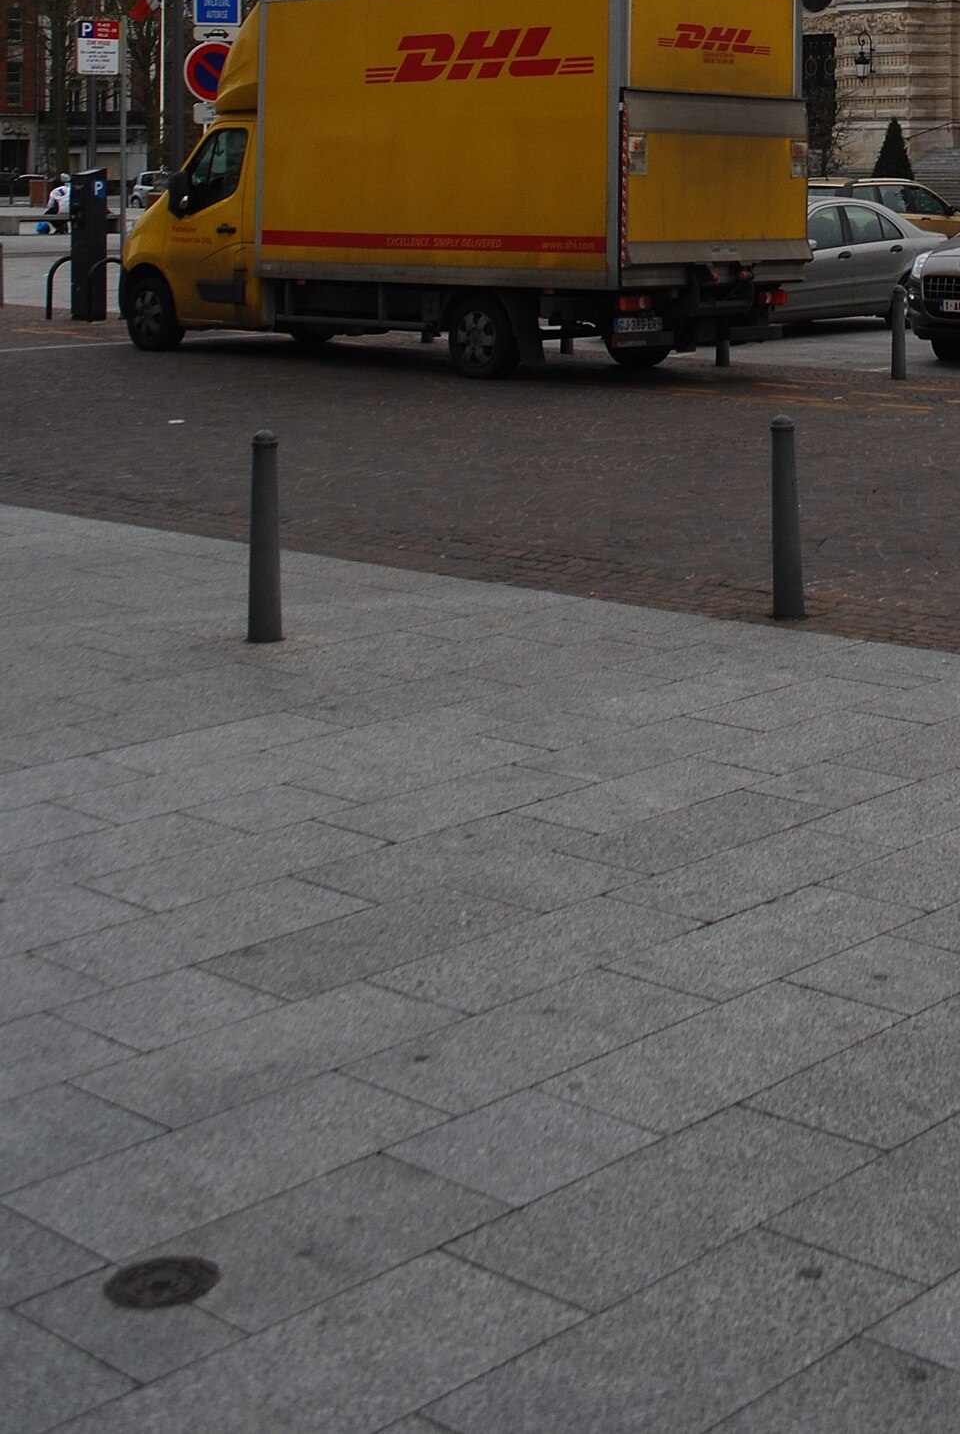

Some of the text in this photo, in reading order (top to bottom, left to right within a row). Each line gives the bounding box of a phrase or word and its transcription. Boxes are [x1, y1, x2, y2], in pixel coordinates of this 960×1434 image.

[82, 22, 93, 37] P
[674, 23, 757, 54] DHL
[394, 26, 561, 83] DHL
[94, 181, 103, 196] P
[433, 238, 459, 248] SIMPLY
[542, 240, 595, 250] www.dhl.com
